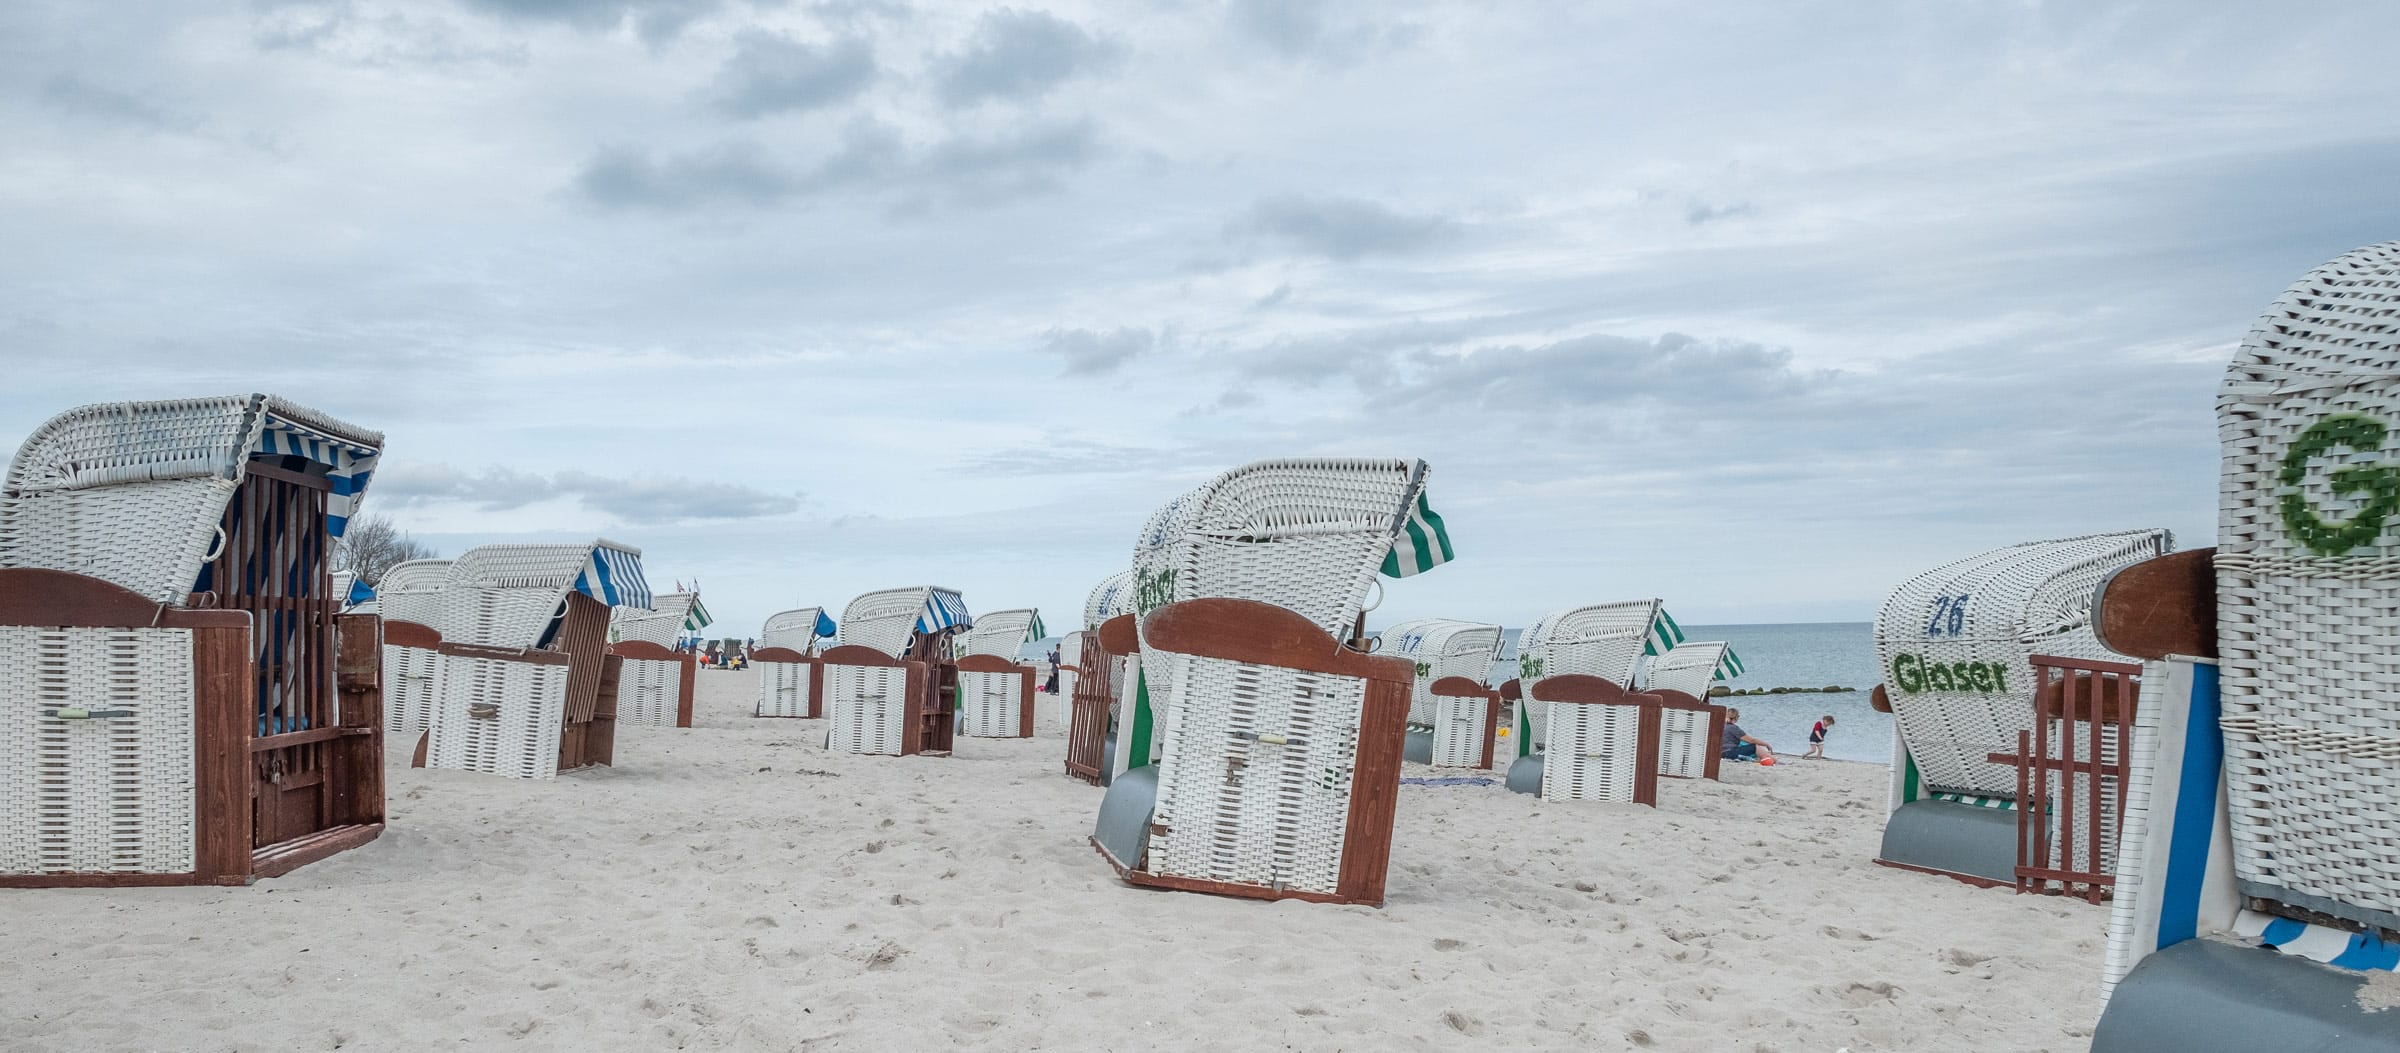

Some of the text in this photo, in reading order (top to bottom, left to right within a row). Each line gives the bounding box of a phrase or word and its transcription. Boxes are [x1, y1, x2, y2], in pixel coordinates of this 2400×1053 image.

[1928, 594, 1969, 637] 26
[1402, 633, 1423, 653] 17
[1893, 652, 2008, 694] Glaser
